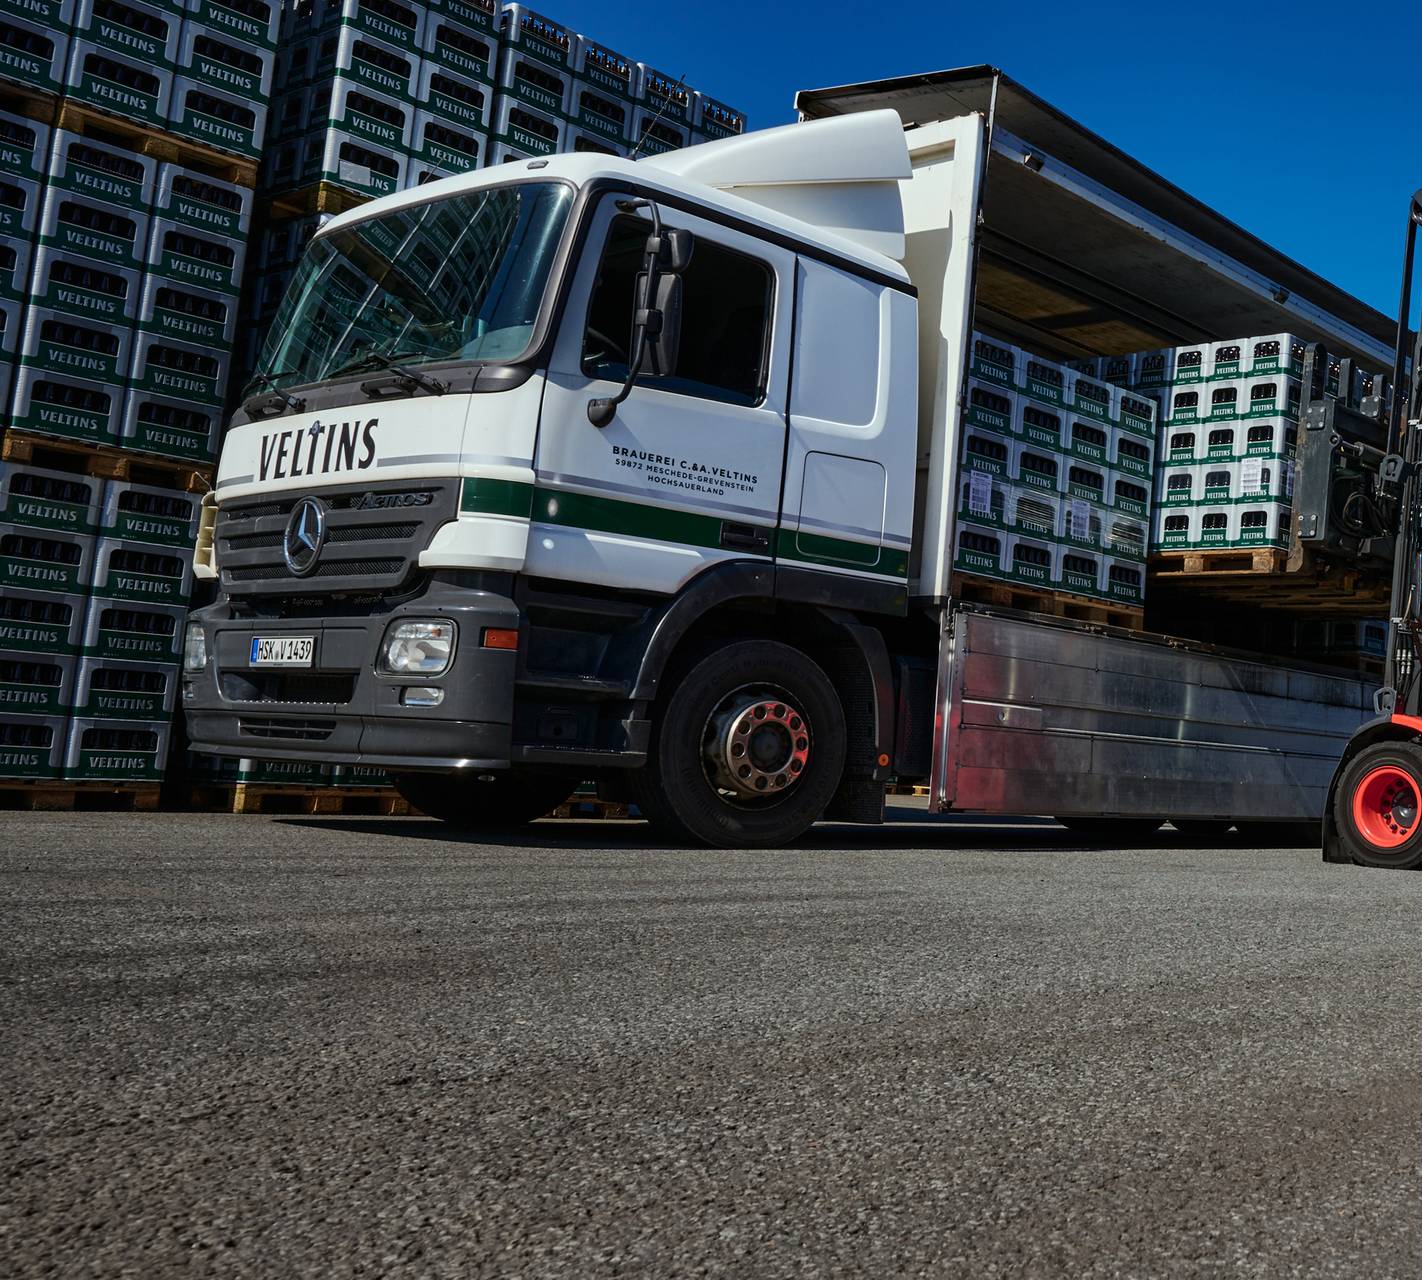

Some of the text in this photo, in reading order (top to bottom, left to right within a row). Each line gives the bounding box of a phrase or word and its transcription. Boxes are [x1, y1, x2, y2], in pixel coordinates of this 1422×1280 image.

[208, 7, 260, 37] VELTINS
[447, 1, 487, 26] VELTINS
[364, 15, 408, 41] VELTINS
[100, 25, 156, 55] VELTINS
[525, 38, 562, 62] VELTINS
[441, 49, 481, 73] VELTINS
[200, 62, 252, 90] VELTINS
[358, 65, 401, 90] VELTINS
[589, 68, 624, 91] VELTINS
[90, 81, 148, 110] VELTINS
[519, 84, 556, 108] VELTINS
[435, 99, 476, 121] VELTINS
[192, 117, 244, 143] VELTINS
[352, 116, 396, 141] VELTINS
[584, 113, 618, 135] VELTINS
[513, 131, 551, 153] VELTINS
[430, 146, 470, 169] VELTINS
[74, 171, 132, 198] VELTINS
[178, 202, 231, 228] VELTINS
[65, 230, 124, 256] VELTINS
[170, 259, 224, 282] VELTINS
[57, 289, 115, 313] VELTINS
[162, 314, 215, 338] VELTINS
[48, 349, 106, 371] VELTINS
[1255, 360, 1277, 371] VELTINS
[980, 363, 1008, 381] VELTINS
[1178, 370, 1199, 380] VELTINS
[1216, 364, 1238, 375] VELTINS
[154, 371, 207, 393] VELTINS
[1031, 383, 1058, 400] VELTINS
[1079, 400, 1104, 416] VELTINS
[1175, 411, 1196, 420] VELTINS
[1213, 407, 1234, 416] VELTINS
[1252, 402, 1274, 412] VELTINS
[39, 409, 98, 430] VELTINS
[976, 411, 1004, 427] VELTINS
[1125, 416, 1147, 431] VELTINS
[145, 429, 199, 449] VELTINS
[1028, 428, 1054, 444] VELTINS
[258, 418, 379, 482] VELTINS
[612, 446, 675, 466] BRAUEREI
[1077, 444, 1101, 458] VELTINS
[1172, 452, 1192, 460] VELTINS
[1210, 448, 1231, 457] VELTINS
[1249, 444, 1270, 453] VELTINS
[972, 458, 1001, 474] VELTINS
[1122, 459, 1145, 473] VELTINS
[615, 458, 754, 493] 59872 MESCHEDE-GREVENSTEIN
[1025, 473, 1051, 488] VELTINS
[647, 475, 725, 496] HOCHSAUERLAND
[1073, 487, 1098, 501] VELTINS
[1206, 489, 1227, 499] VELTINS
[1168, 492, 1189, 502] VELTINS
[18, 502, 77, 522] VELTINS
[1119, 500, 1142, 514] VELTINS
[126, 518, 180, 536] VELTINS
[1022, 519, 1048, 534] VELTINS
[1242, 530, 1264, 540] VELTINS
[1165, 534, 1186, 543] VELTINS
[1203, 531, 1225, 541] VELTINS
[965, 554, 993, 568] VELTINS
[7, 563, 68, 582] VELTINS
[1018, 565, 1045, 579] VELTINS
[116, 577, 172, 594] VELTINS
[1067, 575, 1092, 588] VELTINS
[1113, 584, 1136, 598] VELTINS
[107, 636, 163, 651] VELTINS
[258, 641, 275, 660] HSK
[98, 696, 154, 710] VELTINS
[89, 756, 146, 769] VELTINS
[265, 762, 313, 775] VELTINS
